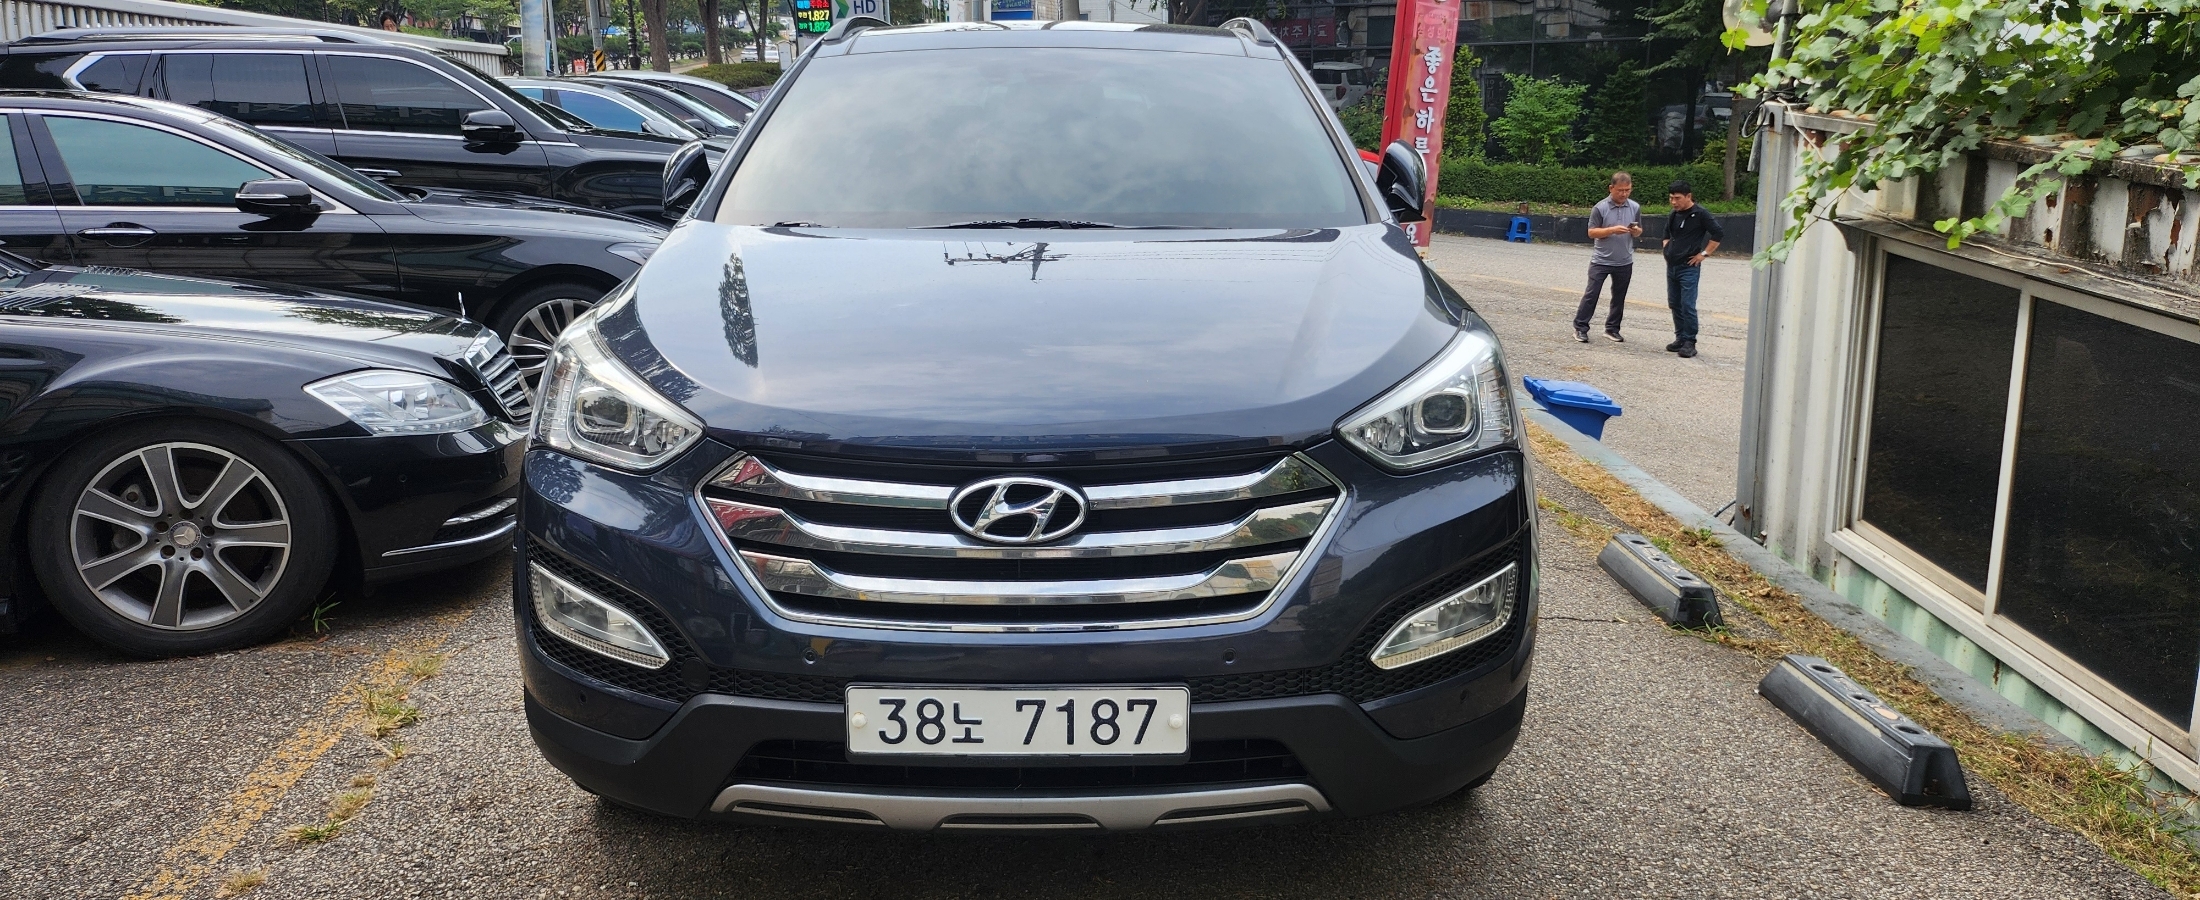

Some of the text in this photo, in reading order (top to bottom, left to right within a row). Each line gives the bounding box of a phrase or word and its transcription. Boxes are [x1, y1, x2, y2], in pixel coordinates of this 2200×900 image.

[854, 0, 876, 14] HD
[808, 10, 830, 21] 1,827
[808, 21, 831, 32] 1,822
[878, 697, 1159, 746] 38노 7187
